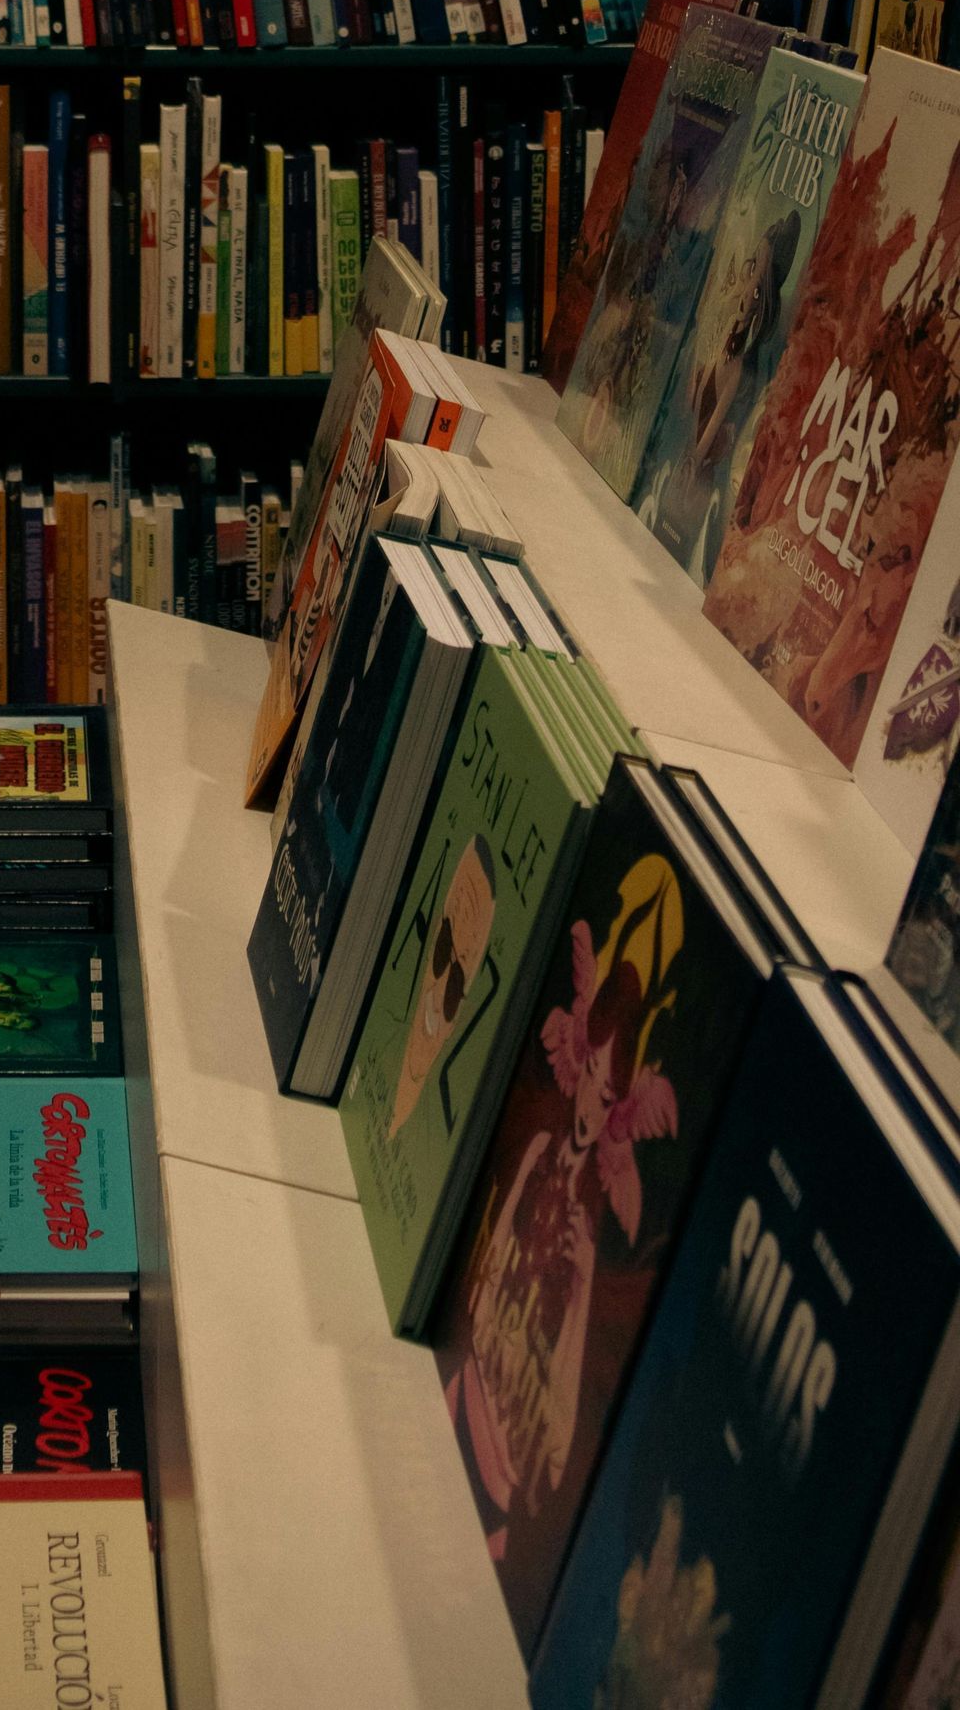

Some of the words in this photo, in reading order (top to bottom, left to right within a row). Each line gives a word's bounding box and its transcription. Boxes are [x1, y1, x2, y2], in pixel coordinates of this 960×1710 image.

[780, 73, 850, 158] WITCH
[530, 153, 544, 233] SEGMENTO
[767, 142, 825, 209] CLUB
[56, 224, 65, 235] W
[235, 229, 245, 245] AL
[55, 237, 65, 279] INFORME
[476, 262, 485, 297] CARGOLS
[56, 282, 65, 292] EL
[234, 290, 244, 324] NADA
[800, 354, 900, 495] MAR
[245, 504, 261, 601] CONTRITION
[767, 526, 804, 575] DAGOLL
[800, 559, 846, 608] DAGOM
[34, 723, 64, 735] EL
[33, 740, 64, 792] GUERRERO
[461, 698, 515, 831] STAN
[499, 775, 548, 908] LEE
[33, 1366, 94, 1458] CORTO
[1, 1423, 19, 1462] Océano
